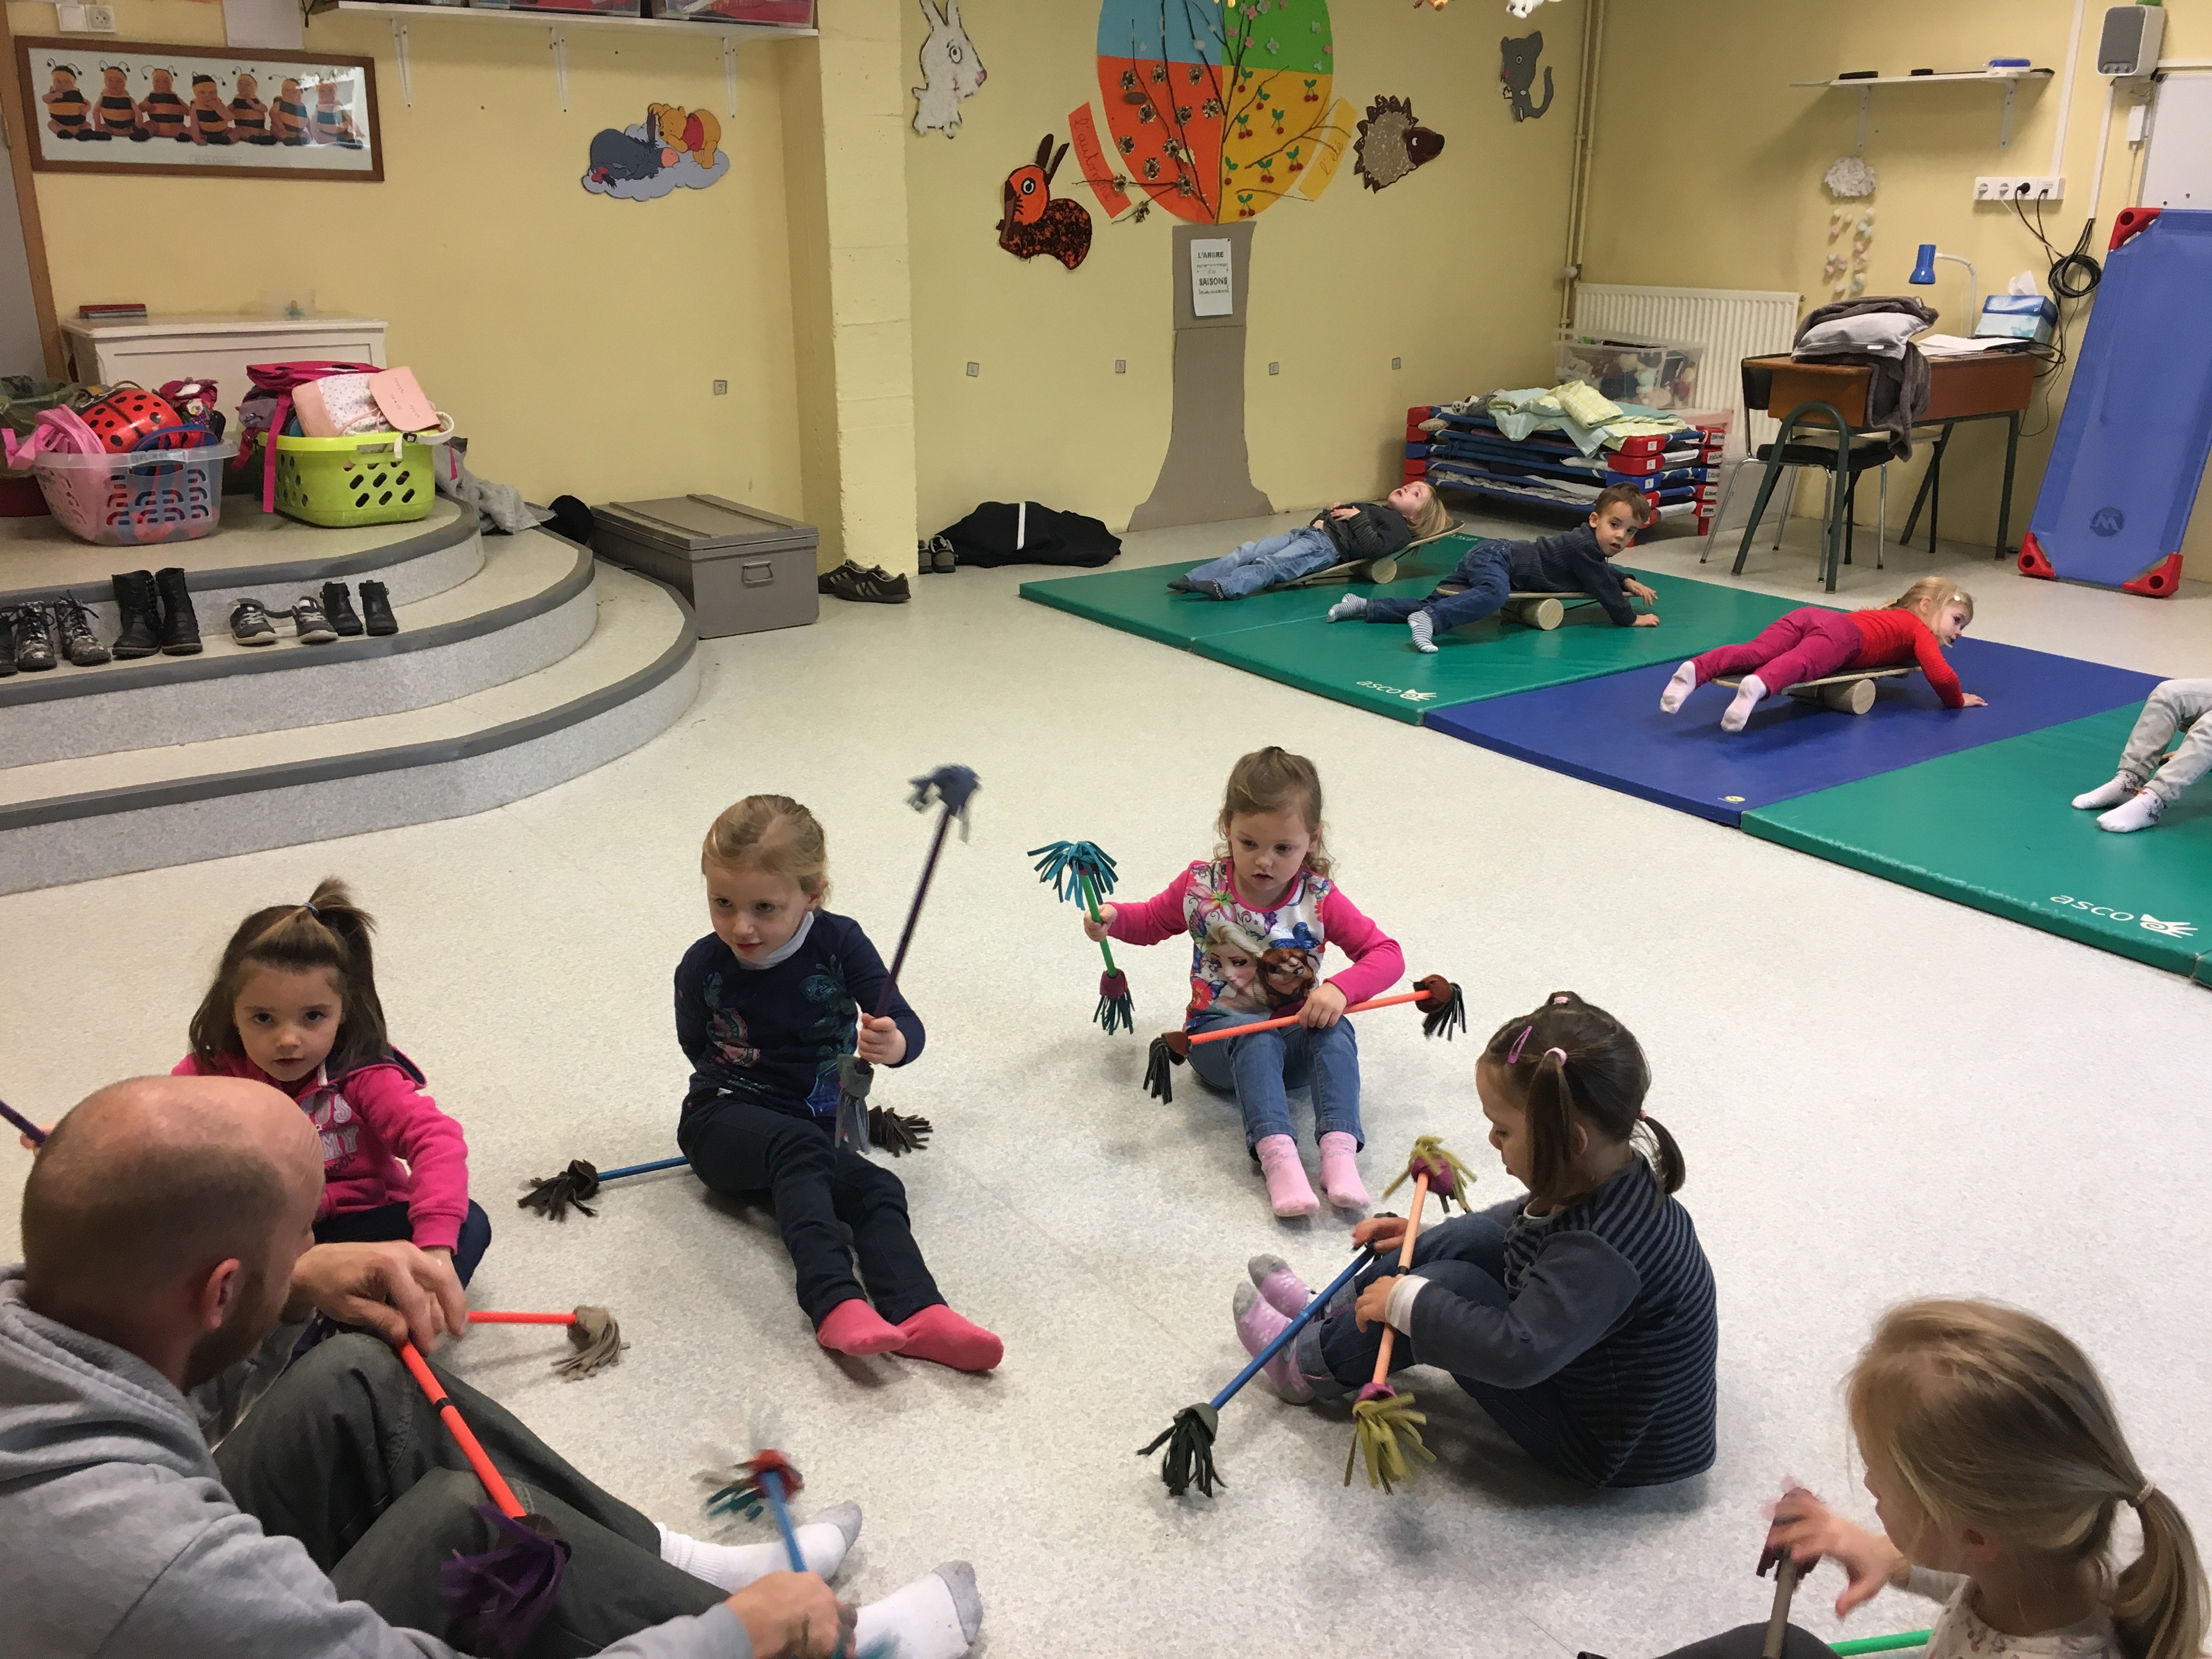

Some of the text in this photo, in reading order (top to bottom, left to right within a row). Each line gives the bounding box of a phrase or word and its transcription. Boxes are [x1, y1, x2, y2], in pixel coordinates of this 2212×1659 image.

[1199, 276, 1228, 286] SAISONS
[1356, 681, 1402, 694] asco
[2050, 895, 2135, 921] asco
